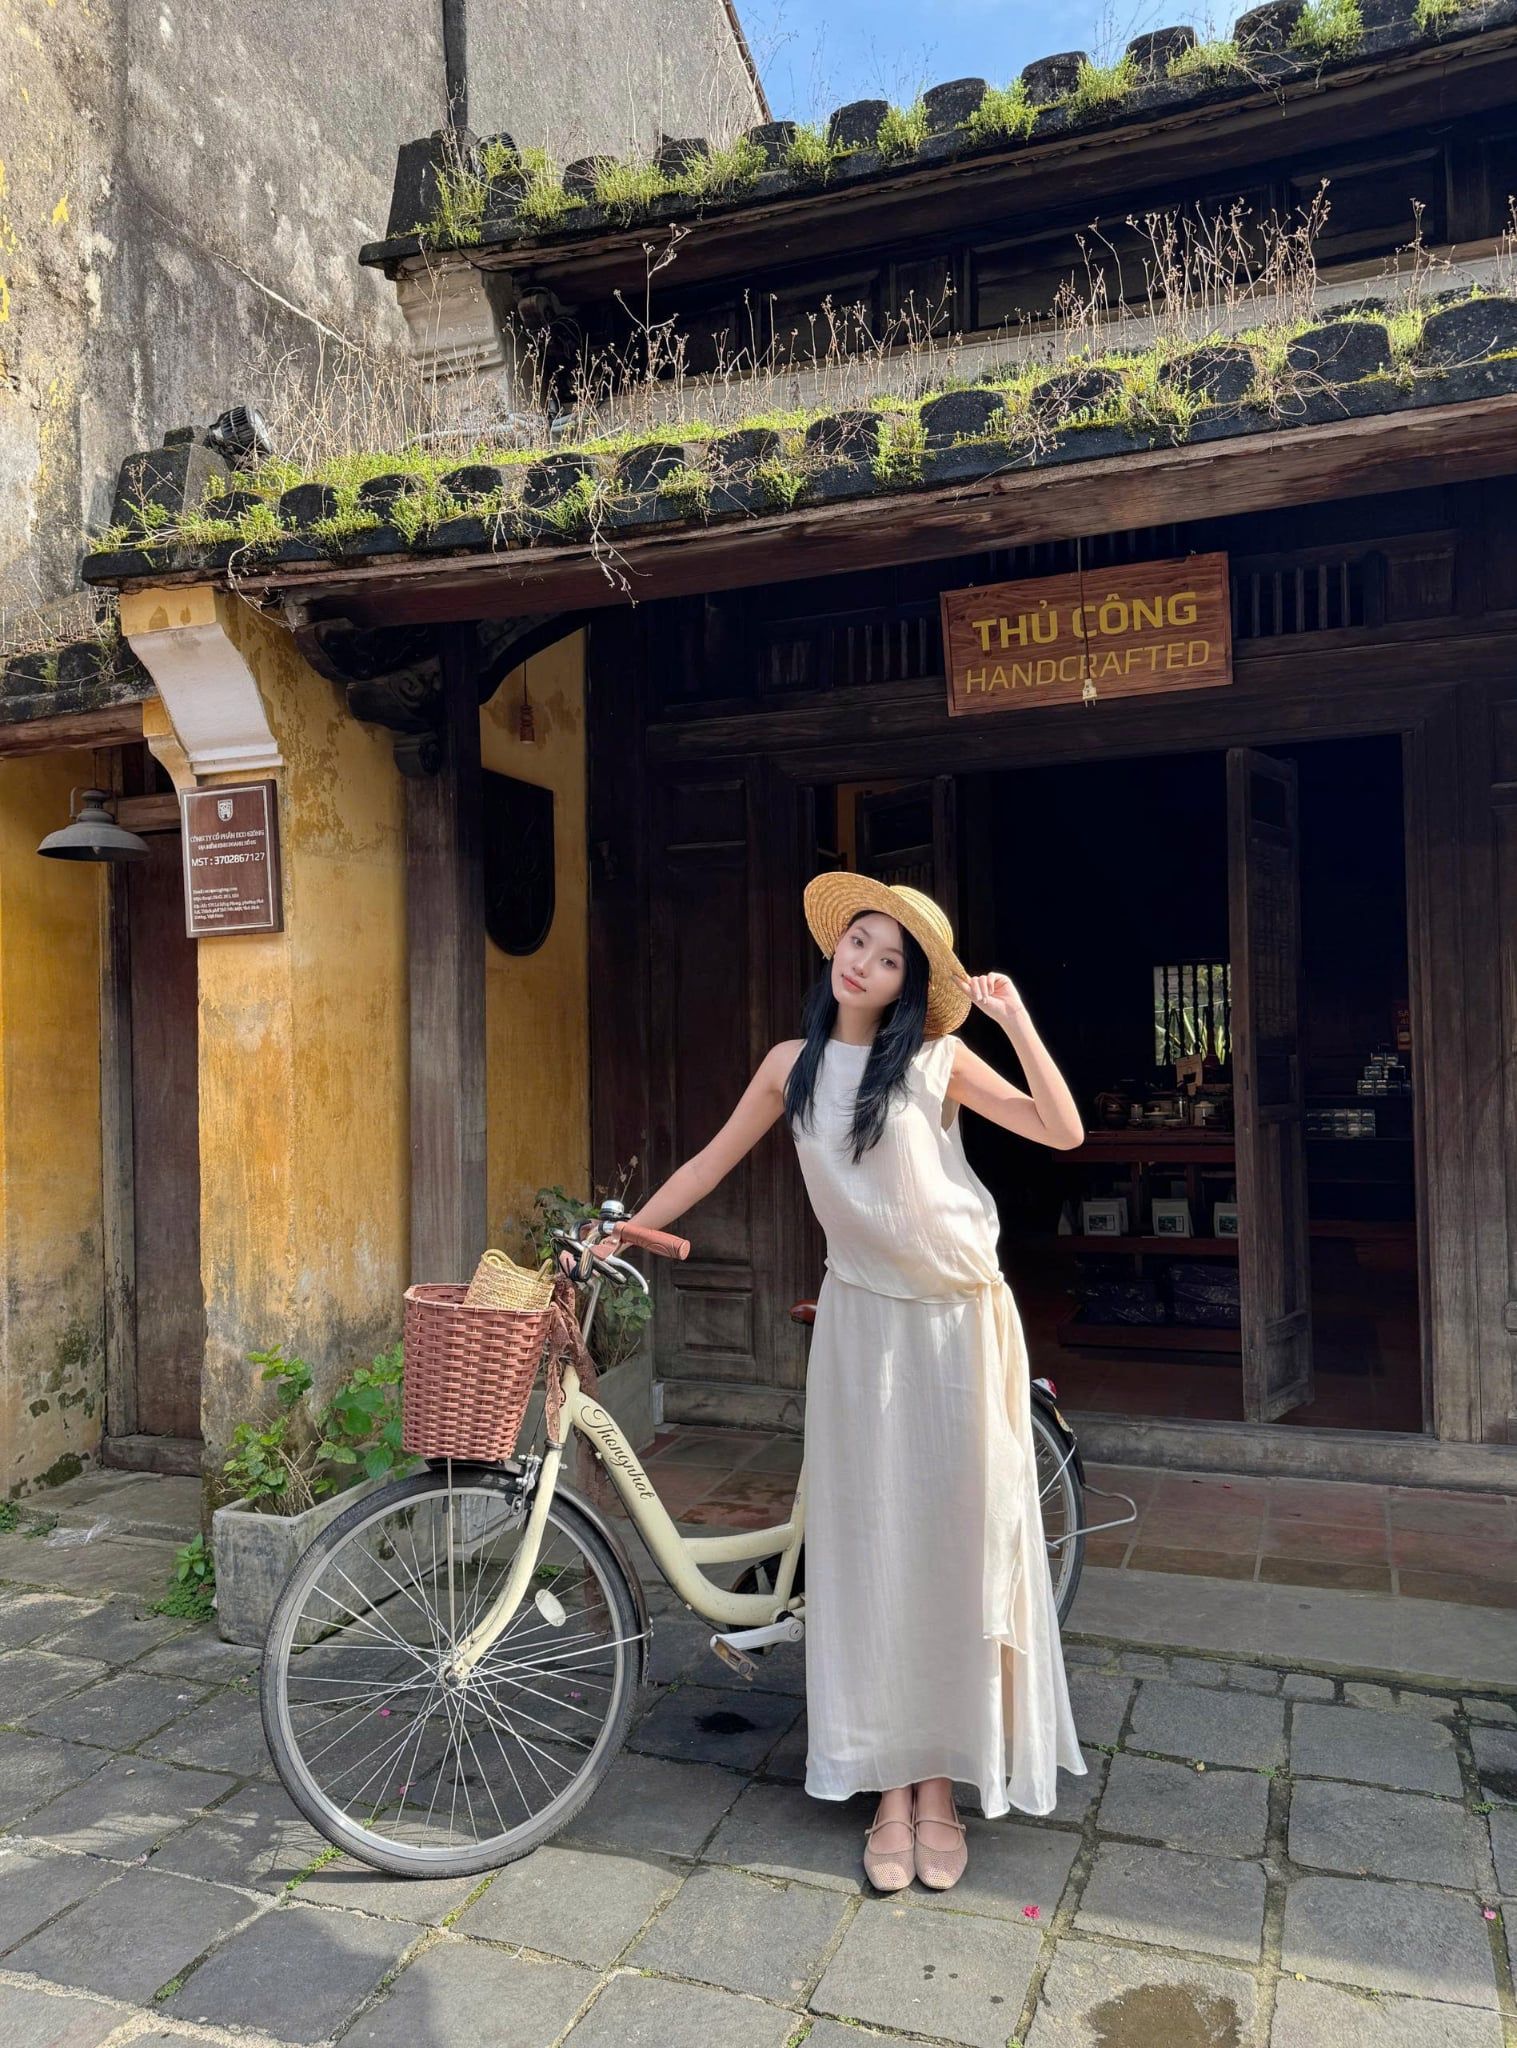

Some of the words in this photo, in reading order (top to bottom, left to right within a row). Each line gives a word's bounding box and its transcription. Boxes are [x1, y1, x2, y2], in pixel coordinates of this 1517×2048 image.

[972, 599, 1059, 652] THỦ
[1072, 591, 1198, 639] CÔNG
[965, 639, 1211, 695] HANDCRAFTED
[191, 857, 208, 867] MST
[214, 852, 265, 866] 3702867127
